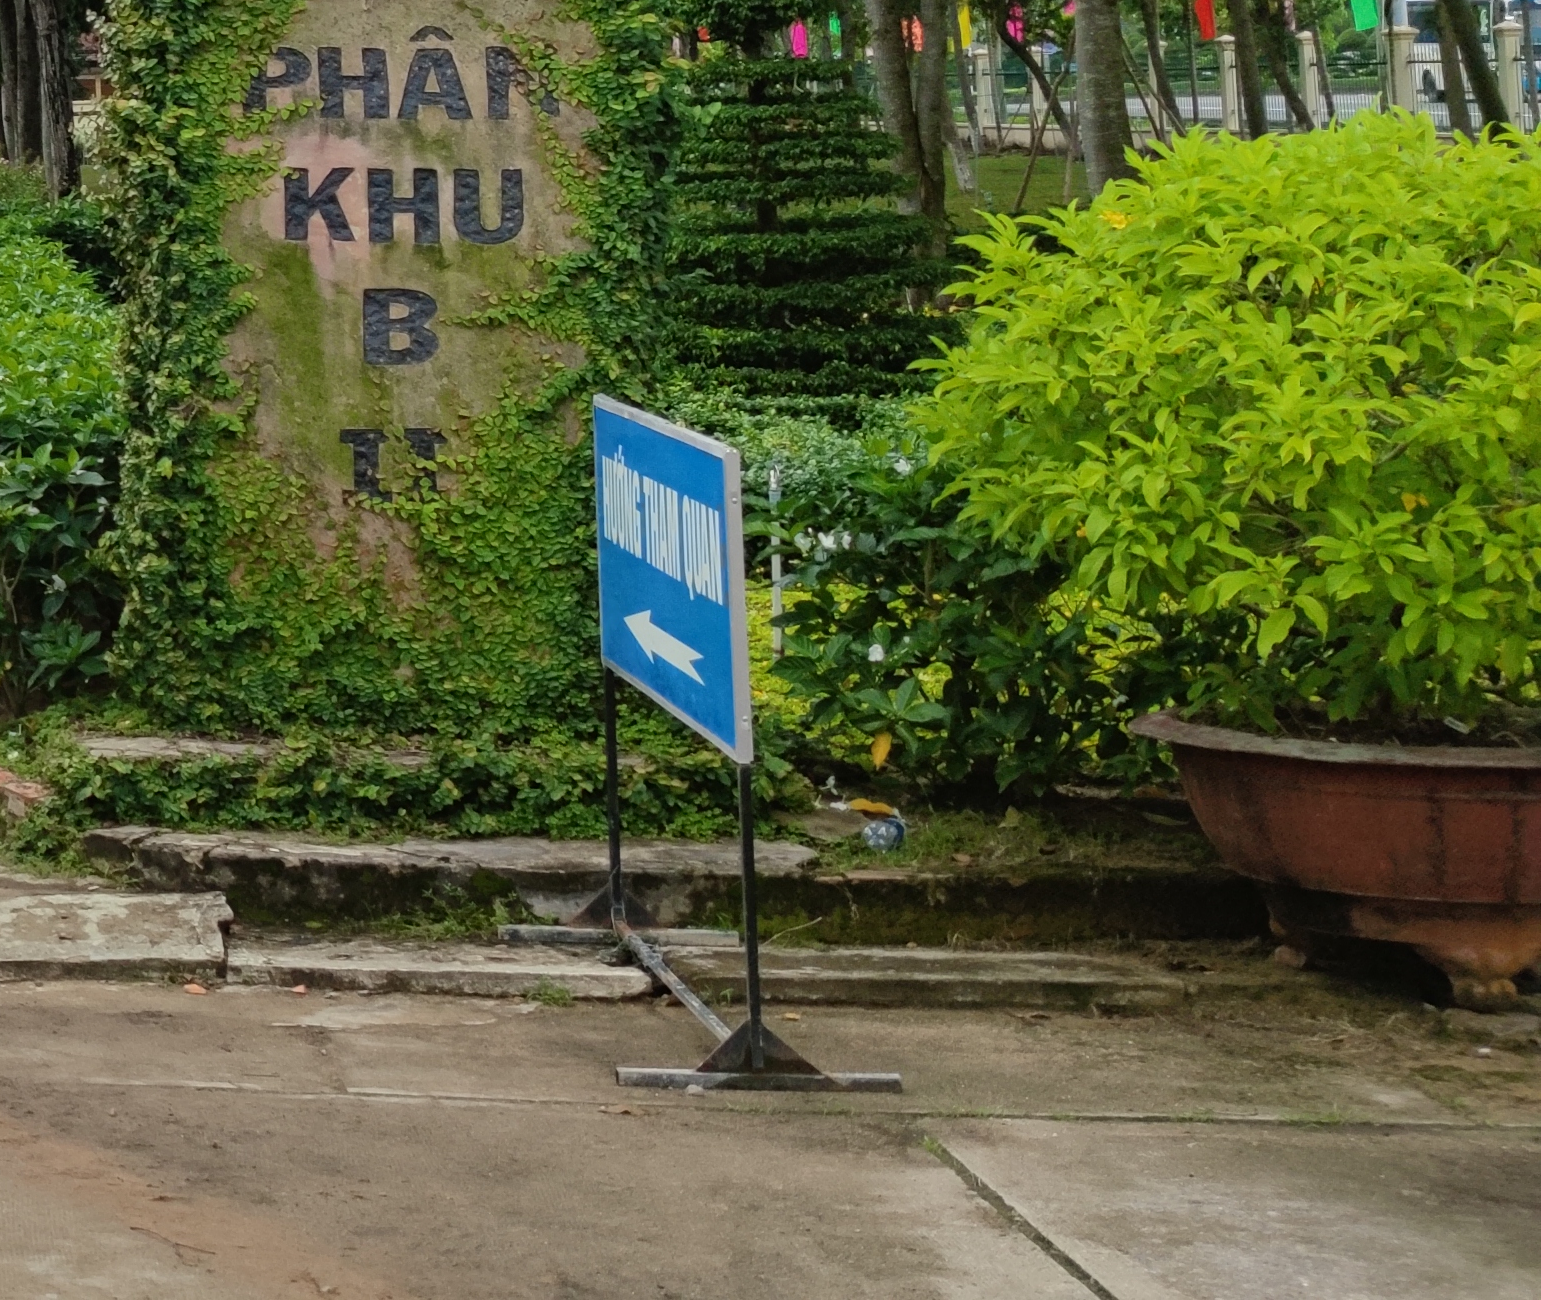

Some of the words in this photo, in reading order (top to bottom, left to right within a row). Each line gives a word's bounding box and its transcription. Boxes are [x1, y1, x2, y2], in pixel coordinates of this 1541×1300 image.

[243, 25, 560, 120] PHÂN
[283, 167, 525, 245] KHU
[363, 288, 439, 366] B
[602, 444, 642, 559] HƯỚNG
[642, 475, 681, 582] THAM
[682, 494, 723, 606] QUAN
